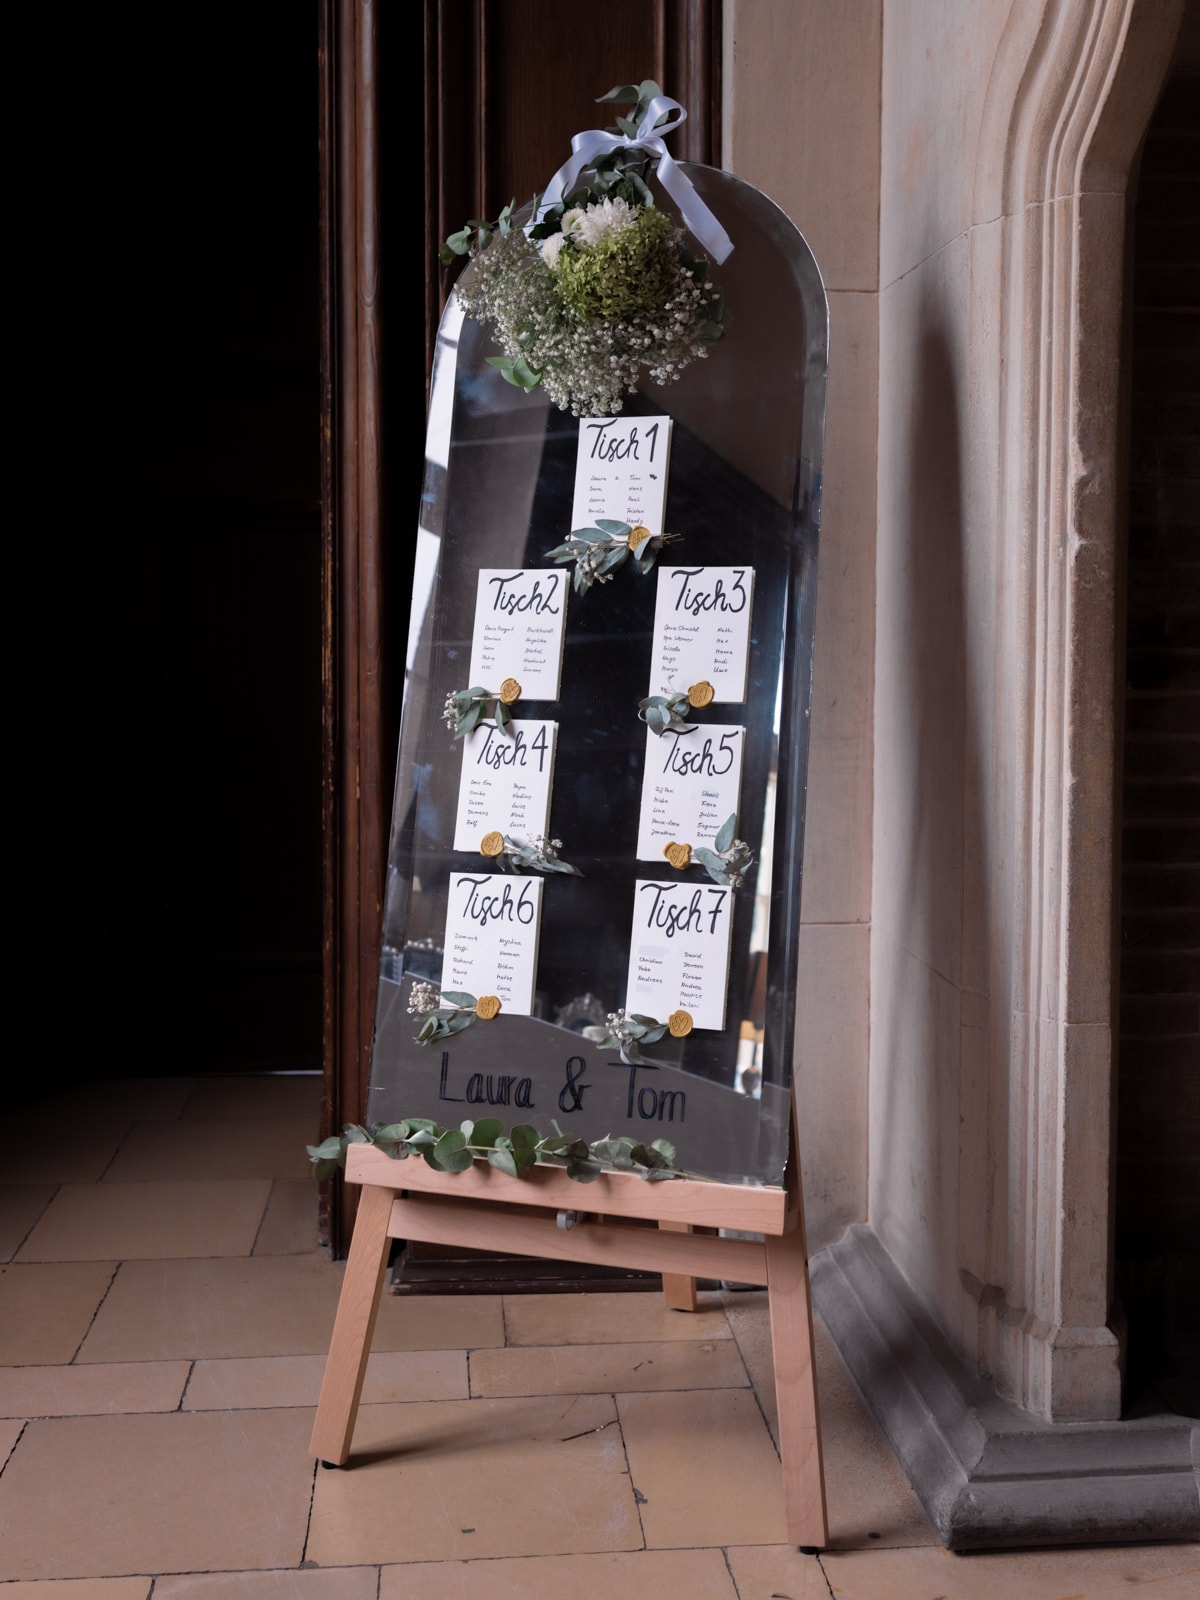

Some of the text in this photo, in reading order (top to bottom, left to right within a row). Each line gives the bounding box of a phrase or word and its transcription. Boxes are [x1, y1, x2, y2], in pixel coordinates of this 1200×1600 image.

[587, 418, 659, 462] Tisch 1
[489, 572, 560, 615] Tisch 2
[671, 567, 747, 616] Tisch 3
[473, 721, 549, 772] Tisch 4
[659, 725, 739, 776] Tisch 5
[457, 876, 534, 926] Tisch 6
[640, 883, 728, 938] Tisch 7
[439, 1052, 686, 1123] Laura & Tom
